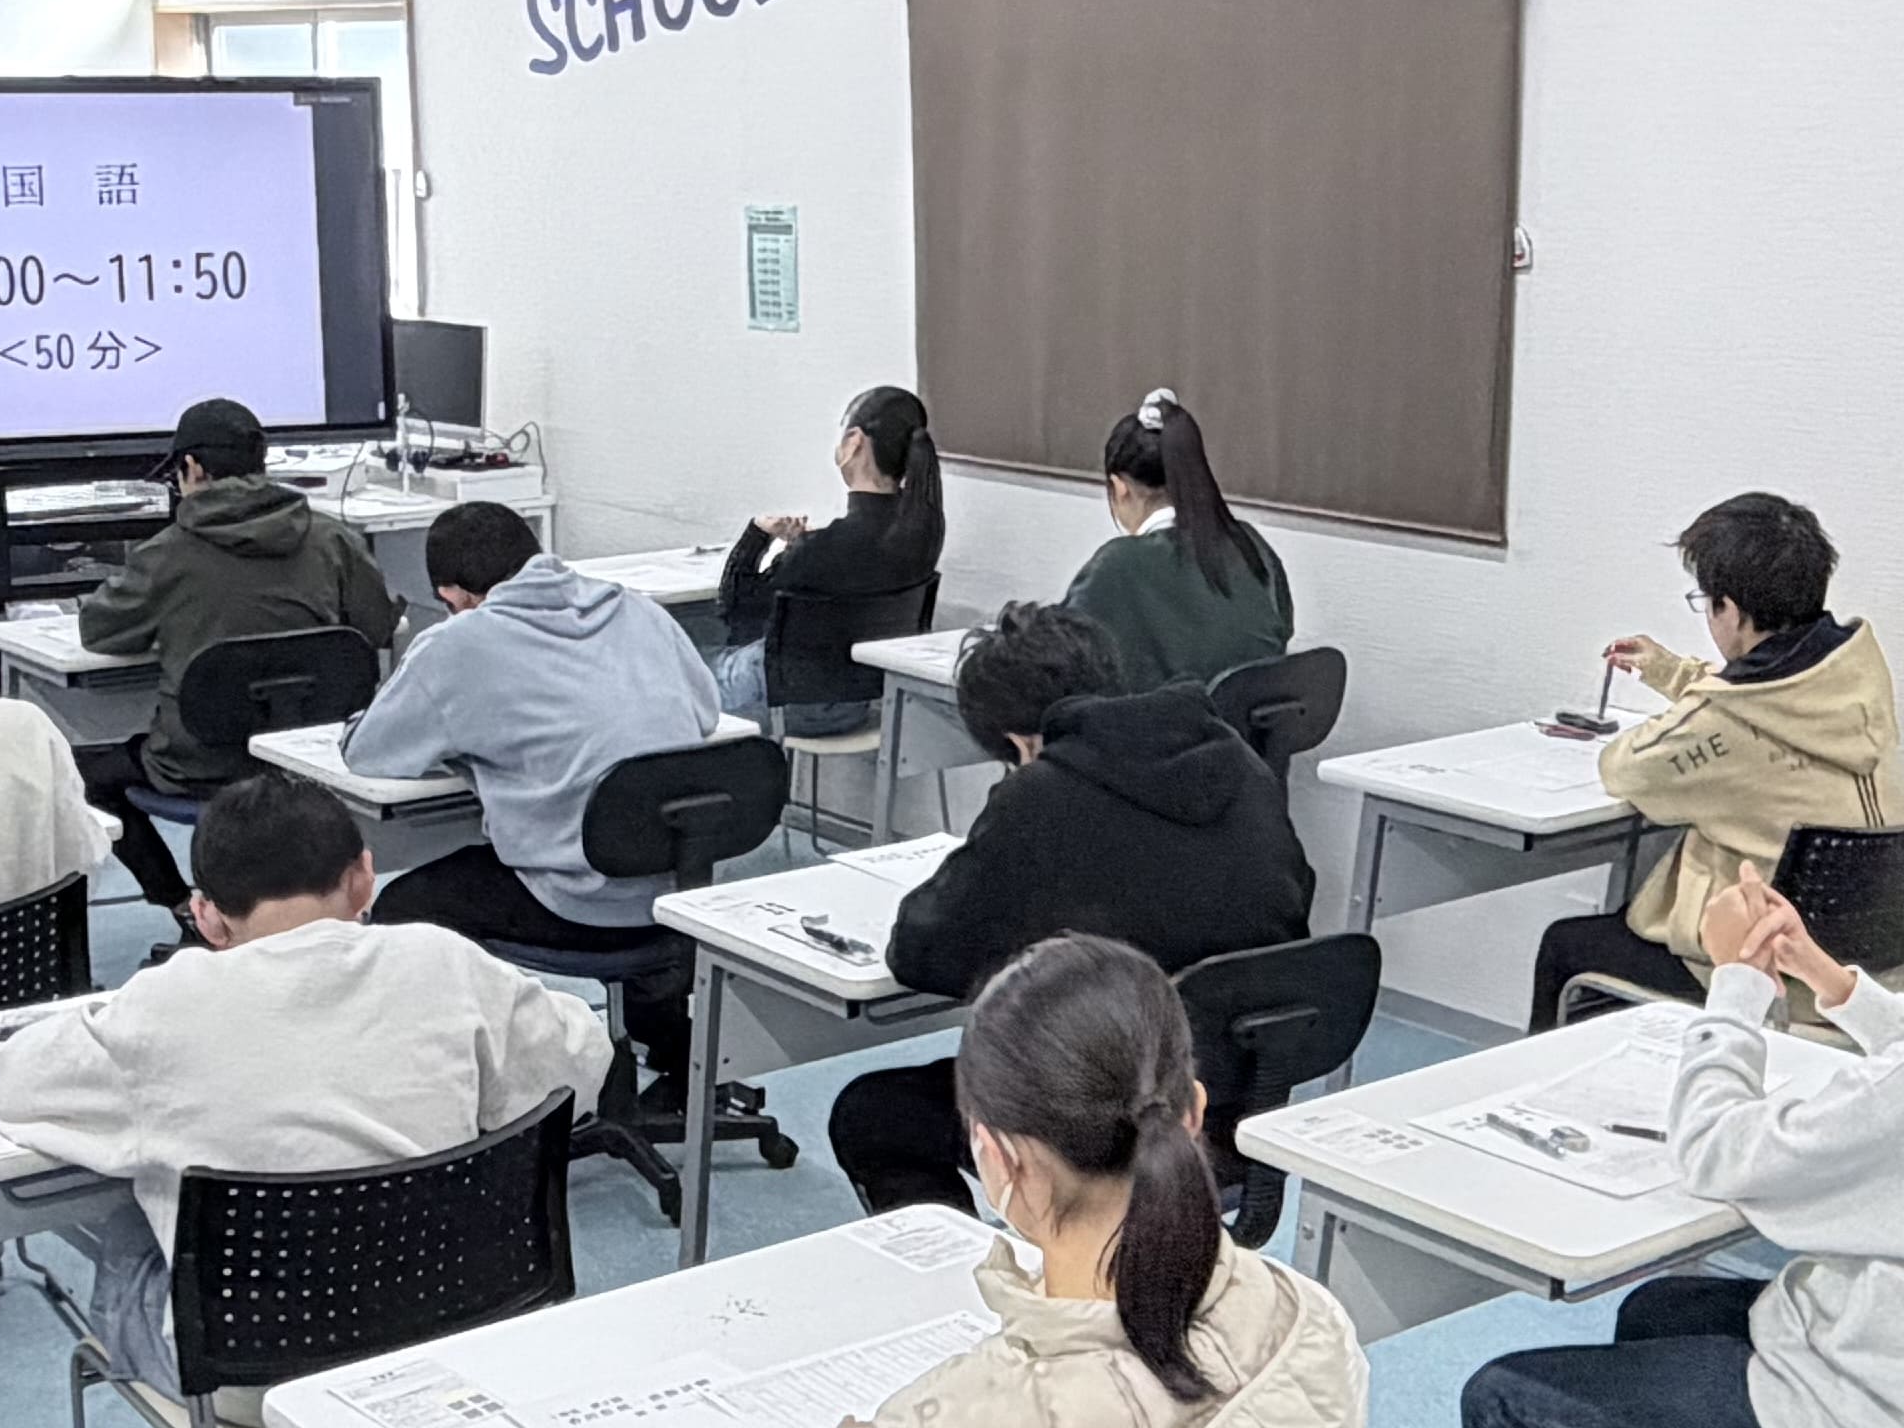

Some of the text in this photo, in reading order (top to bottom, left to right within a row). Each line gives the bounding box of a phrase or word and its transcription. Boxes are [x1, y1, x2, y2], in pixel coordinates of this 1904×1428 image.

[2, 163, 139, 207] 国 語
[1667, 732, 1730, 775] THE
